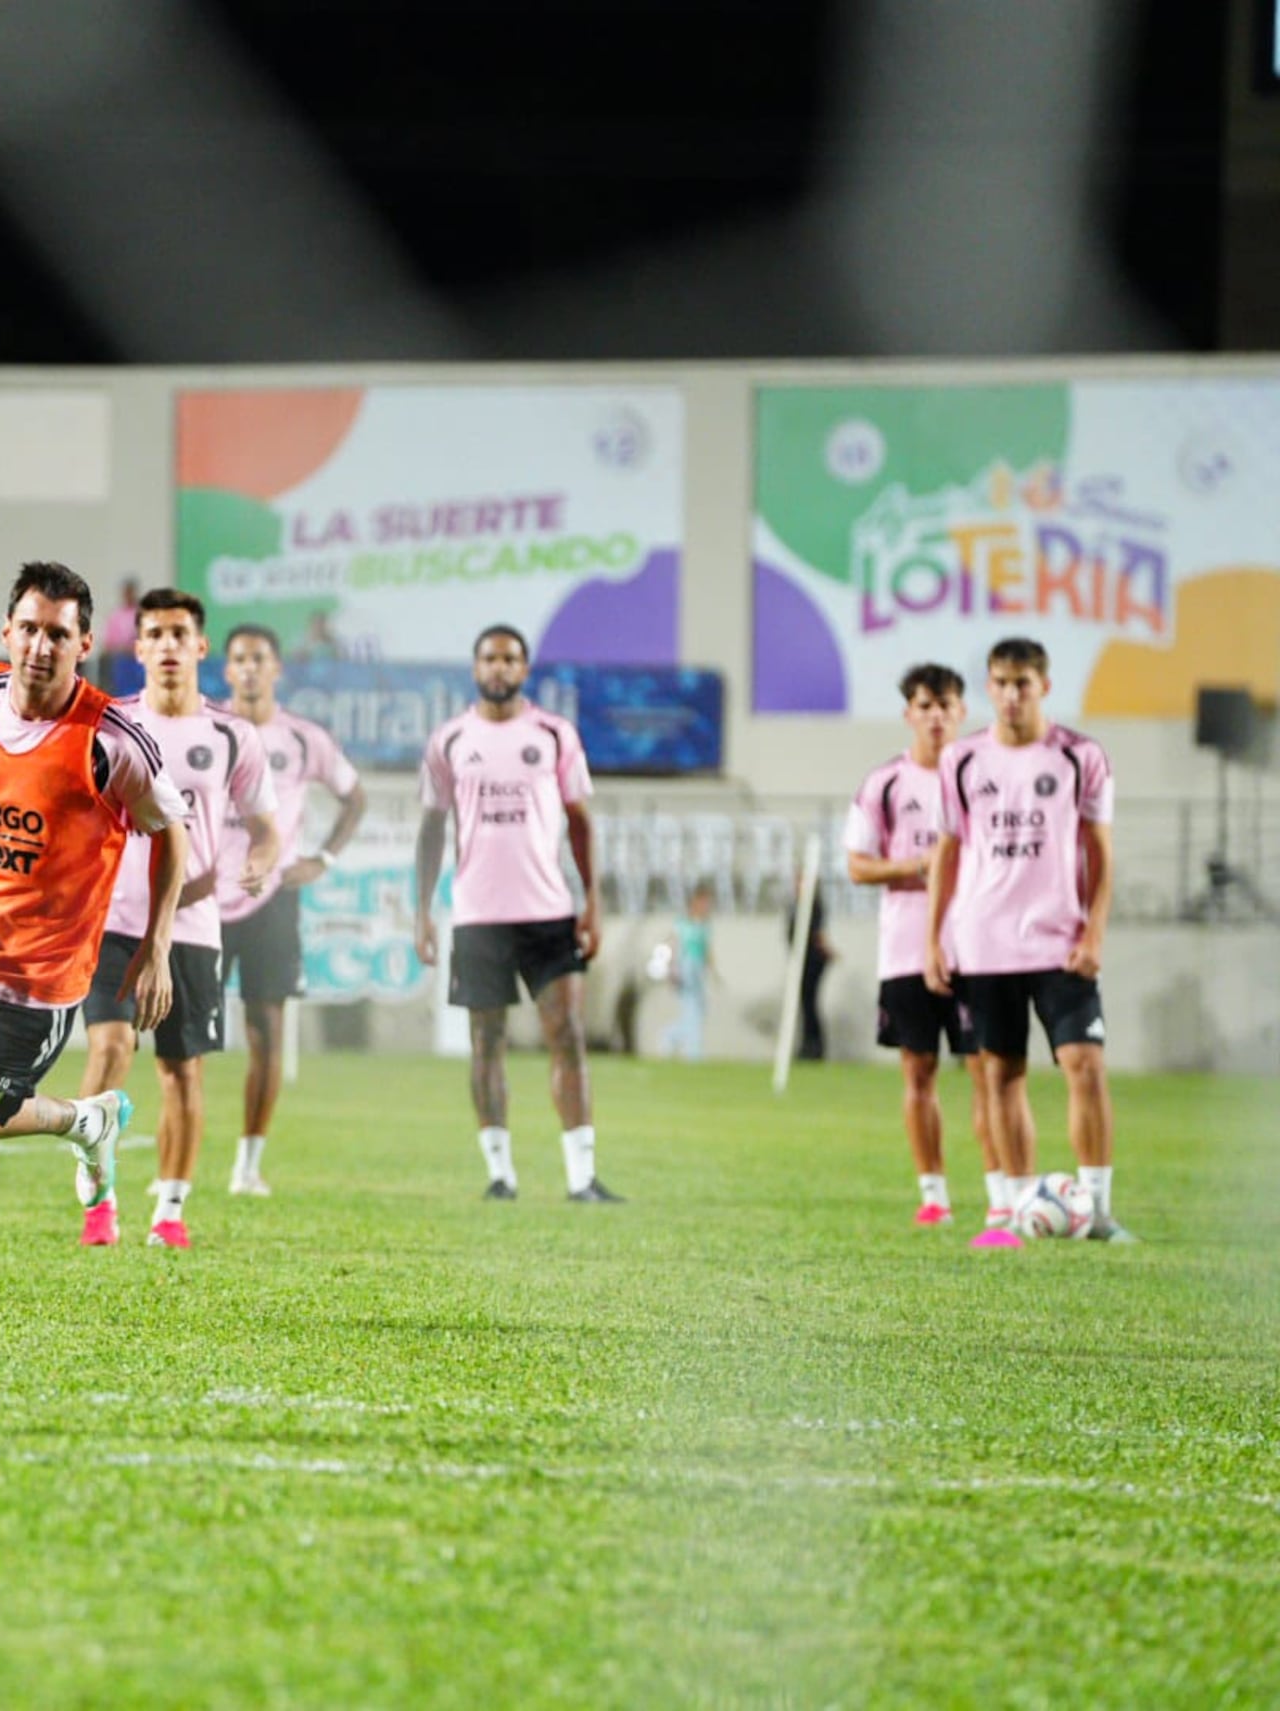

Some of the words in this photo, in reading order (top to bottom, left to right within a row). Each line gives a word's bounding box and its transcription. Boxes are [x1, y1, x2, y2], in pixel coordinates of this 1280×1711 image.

[292, 510, 353, 548] LA
[369, 494, 566, 543] SUERTE
[349, 531, 639, 590] BUSCANDO
